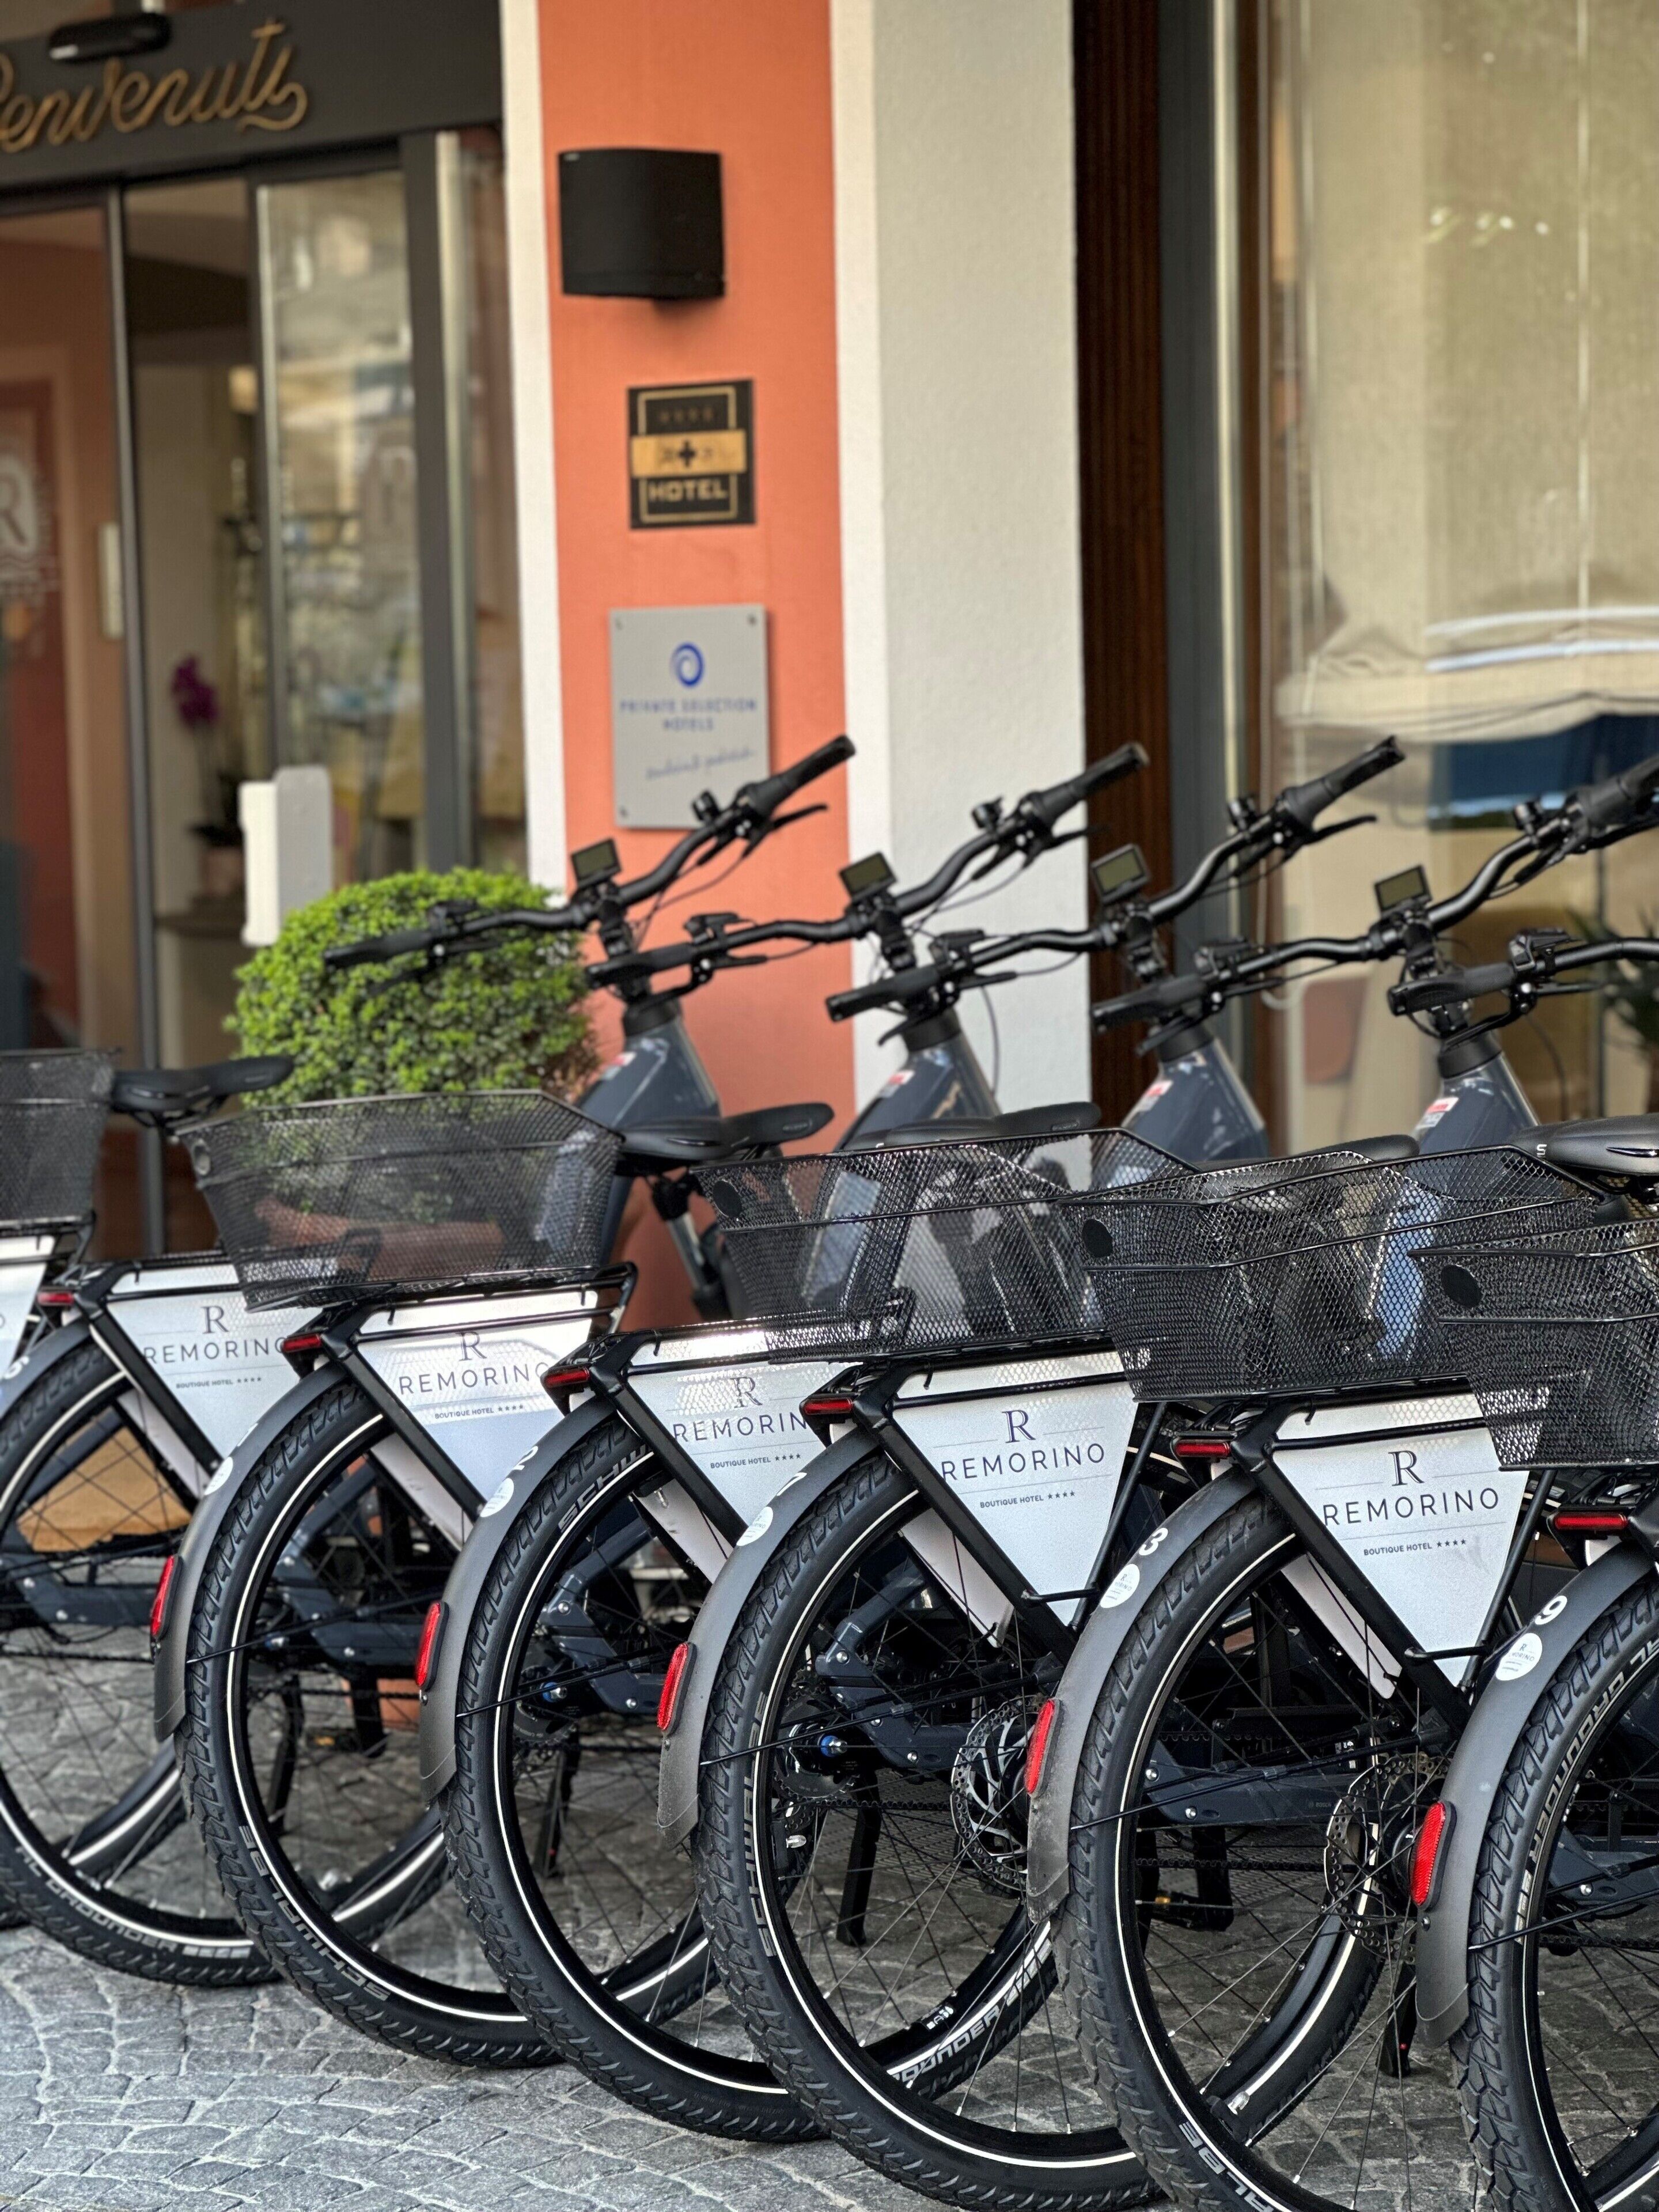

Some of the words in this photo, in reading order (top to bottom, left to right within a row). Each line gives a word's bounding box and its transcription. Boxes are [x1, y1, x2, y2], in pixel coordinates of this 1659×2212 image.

[647, 479, 728, 502] HOTEL
[201, 1304, 229, 1335] R
[456, 1331, 487, 1361] R
[176, 1380, 210, 1389] BOUTIQUE
[212, 1378, 234, 1387] HOTEL
[730, 1376, 763, 1408] R
[434, 1410, 471, 1419] BOUTIQUE
[673, 1411, 807, 1442] REMORIN
[1002, 1409, 1036, 1444] R
[710, 1459, 747, 1469] BOUTIQUE
[748, 1456, 771, 1465] HOTEL
[941, 1443, 1105, 1481] REMORINO
[1388, 1450, 1425, 1487] R
[980, 1498, 1018, 1509] BOUTIQUE
[1020, 1494, 1044, 1503] HOTEL
[1323, 1487, 1499, 1526] REMORINO
[1138, 1527, 1169, 1556] 3
[1363, 1545, 1404, 1556] BOUTIQUE
[1407, 1541, 1433, 1551] HOTEL
[1535, 1594, 1568, 1625] 9
[238, 1825, 392, 2001] SCHWALBE
